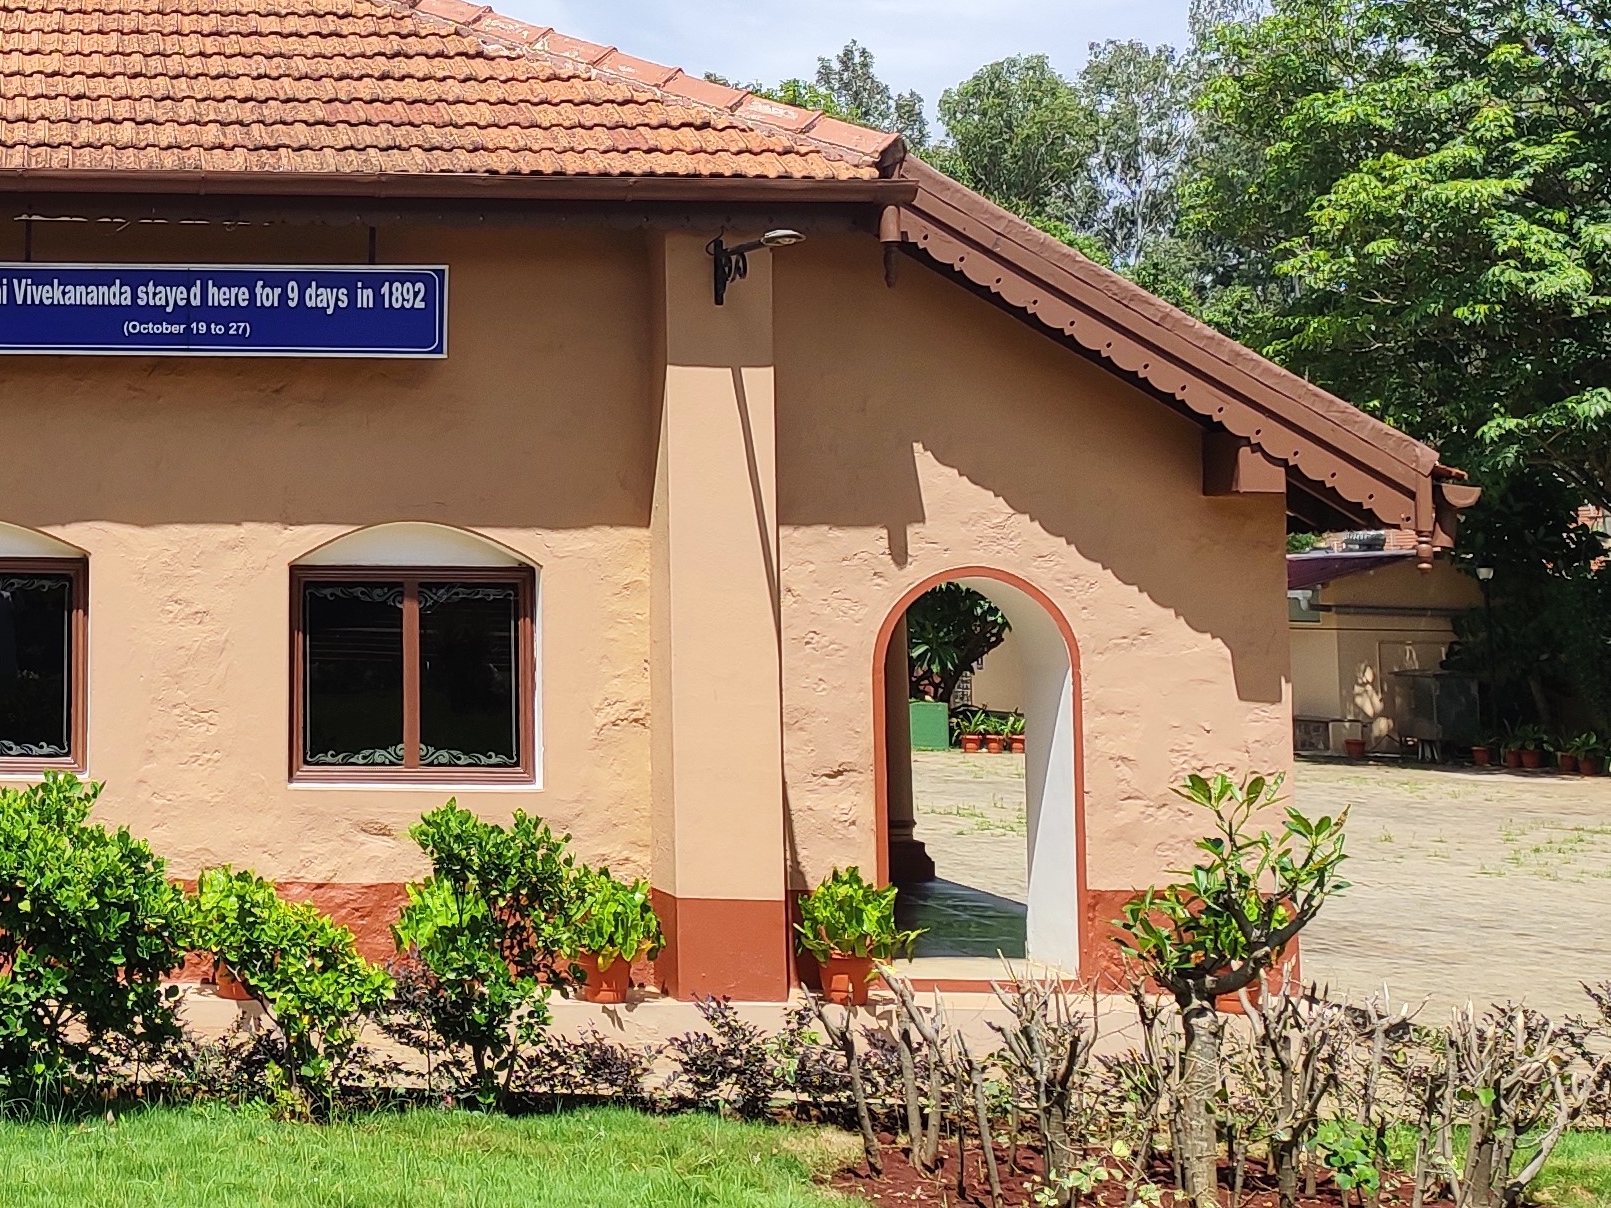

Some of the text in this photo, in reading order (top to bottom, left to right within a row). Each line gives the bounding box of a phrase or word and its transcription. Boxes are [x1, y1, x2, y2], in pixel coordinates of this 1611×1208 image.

[12, 278, 132, 307] Vivekananda
[136, 279, 201, 313] stayed
[207, 279, 250, 307] here
[255, 280, 282, 307] for
[287, 280, 299, 308] 9
[305, 281, 349, 315] days
[357, 281, 374, 308] in
[380, 281, 426, 309] 1892
[123, 321, 251, 338] (October 19 to 27)
